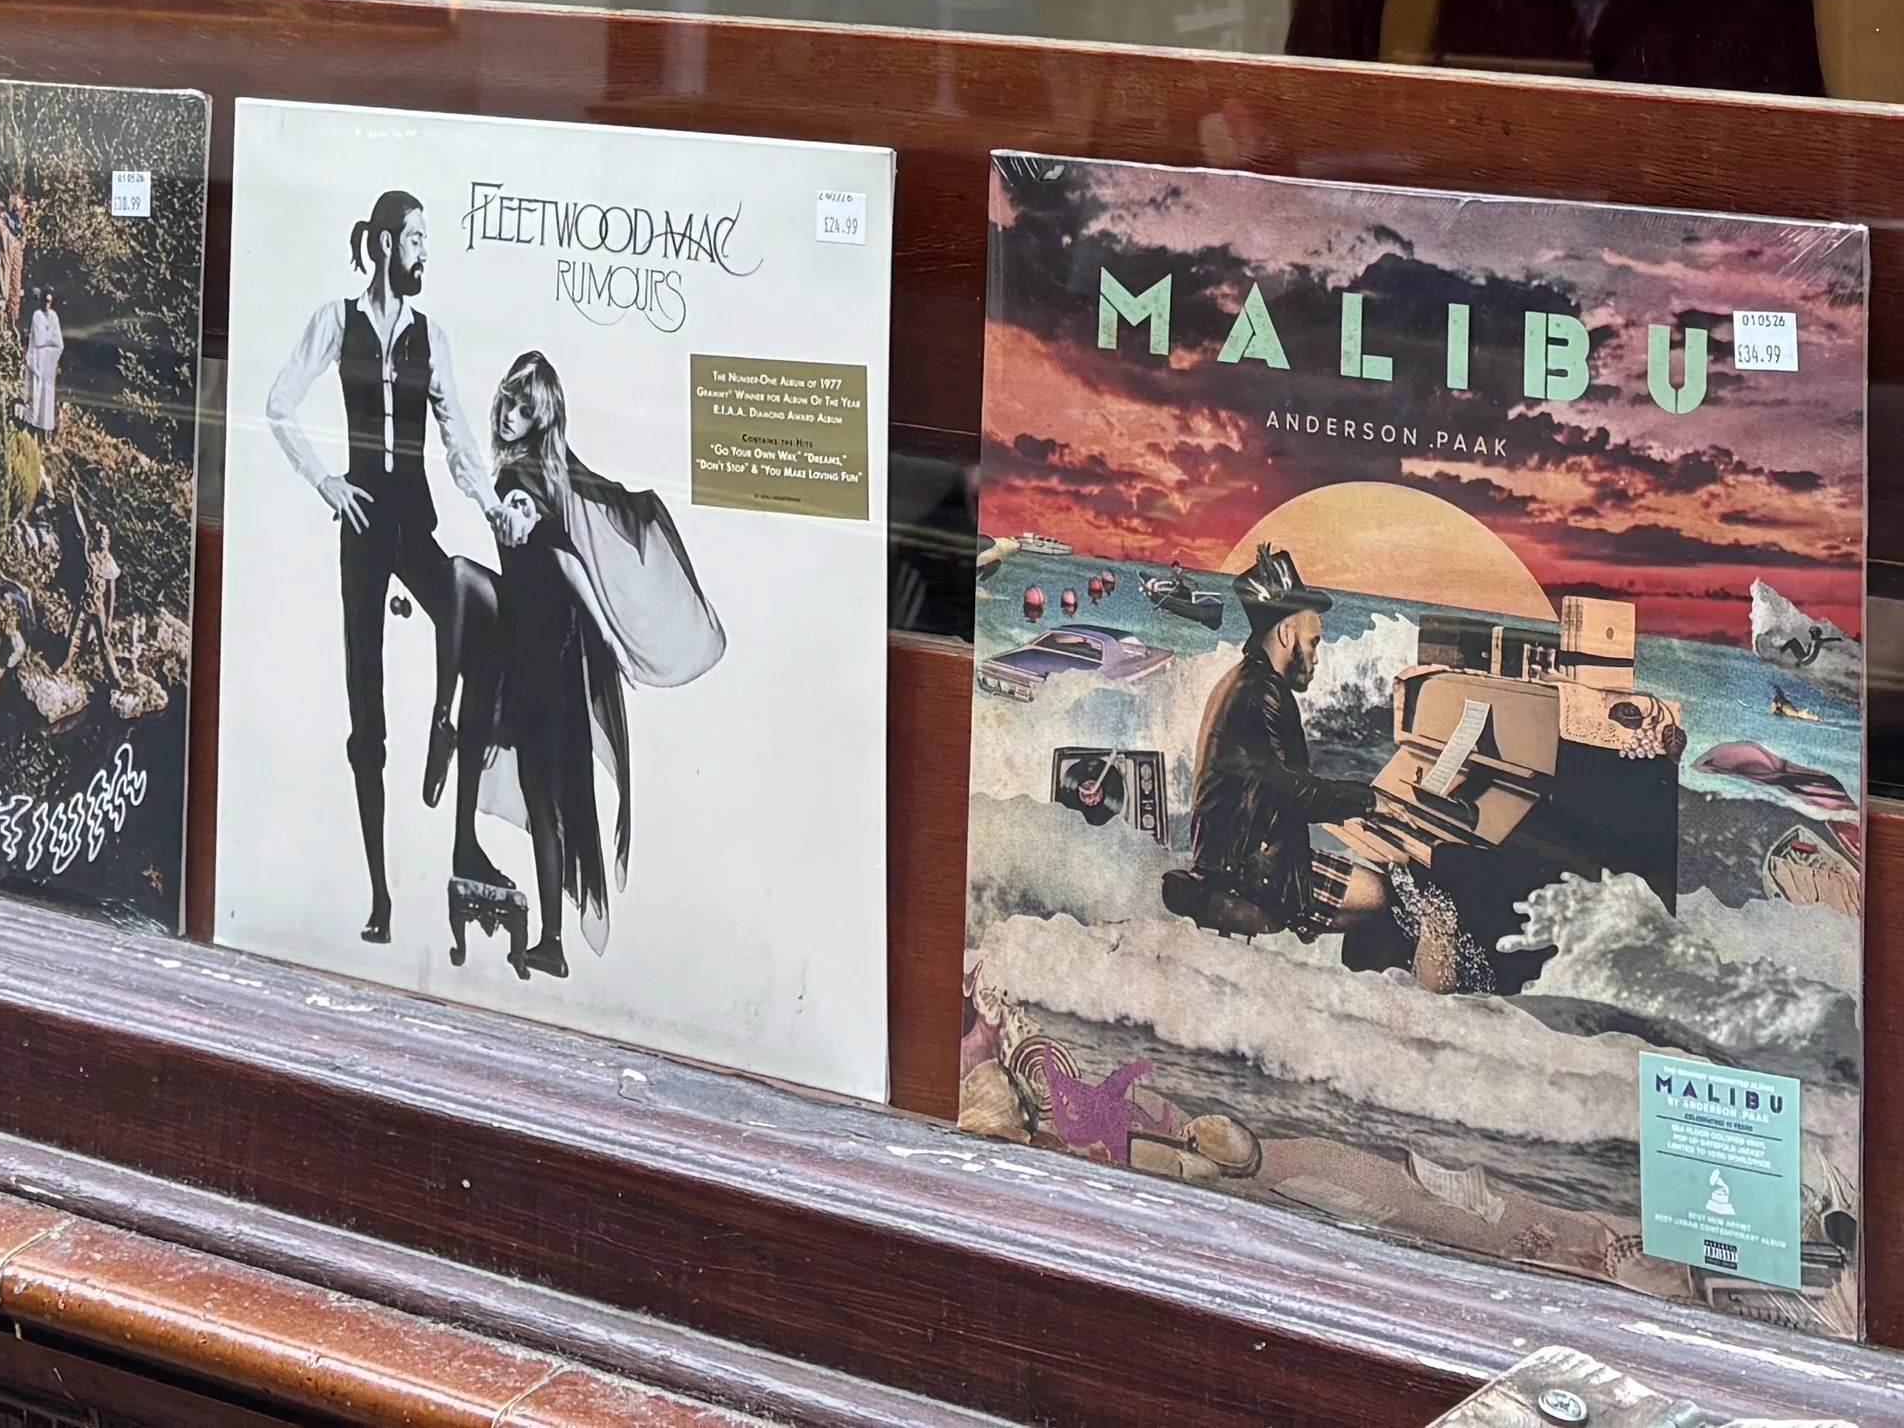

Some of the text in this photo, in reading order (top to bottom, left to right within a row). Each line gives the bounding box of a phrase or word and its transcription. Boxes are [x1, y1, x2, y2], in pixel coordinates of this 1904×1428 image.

[461, 181, 764, 277] FLEETWOOD MAC
[823, 216, 859, 236] £24.99
[555, 259, 686, 333] RUMOURS
[1097, 265, 1708, 415] MALIBU
[1737, 343, 1782, 365] £34.99
[1266, 410, 1508, 458] ANDERSON .PAAK
[1655, 1073, 1783, 1114] MALIBU
